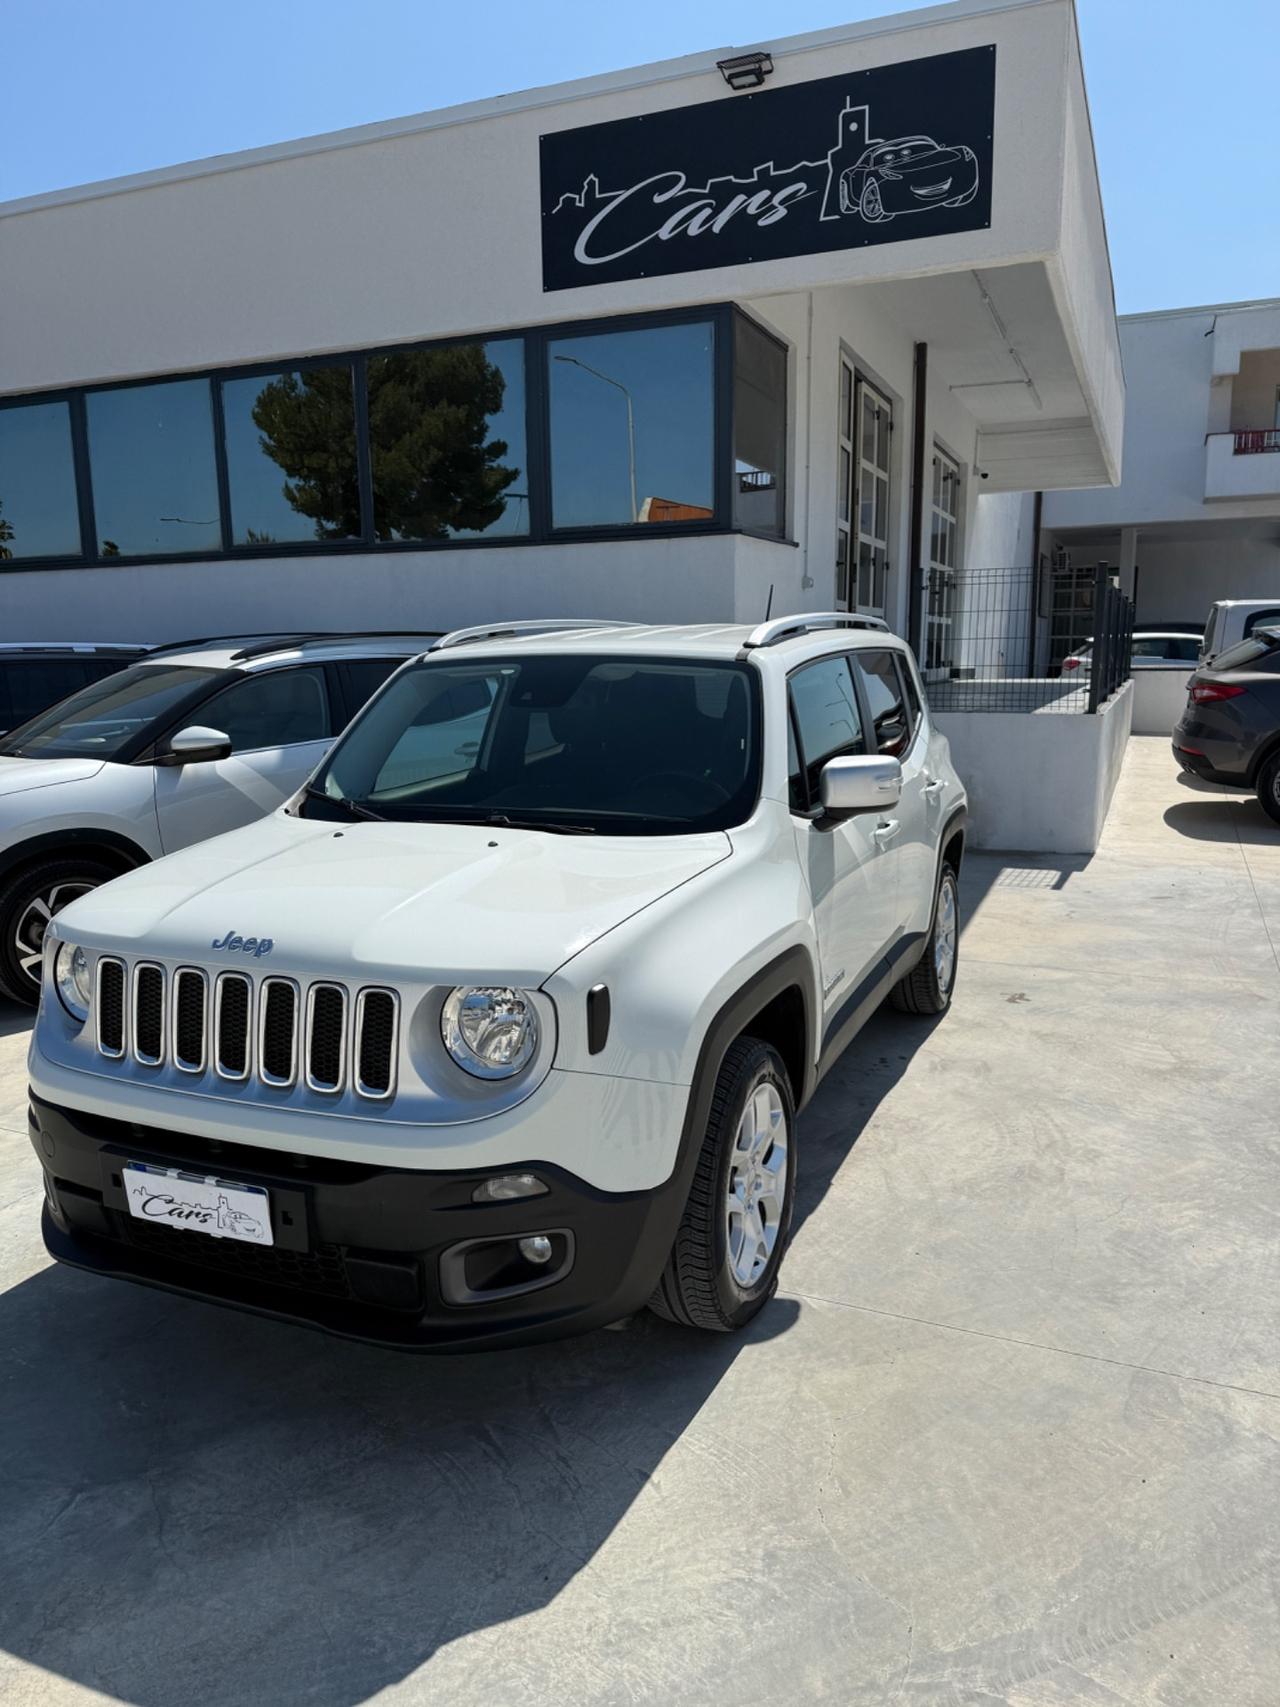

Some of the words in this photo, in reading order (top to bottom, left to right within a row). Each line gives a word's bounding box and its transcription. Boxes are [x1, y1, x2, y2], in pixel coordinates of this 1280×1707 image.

[574, 171, 817, 264] Cars
[211, 930, 274, 958] Jeep
[142, 1194, 214, 1223] Cars
